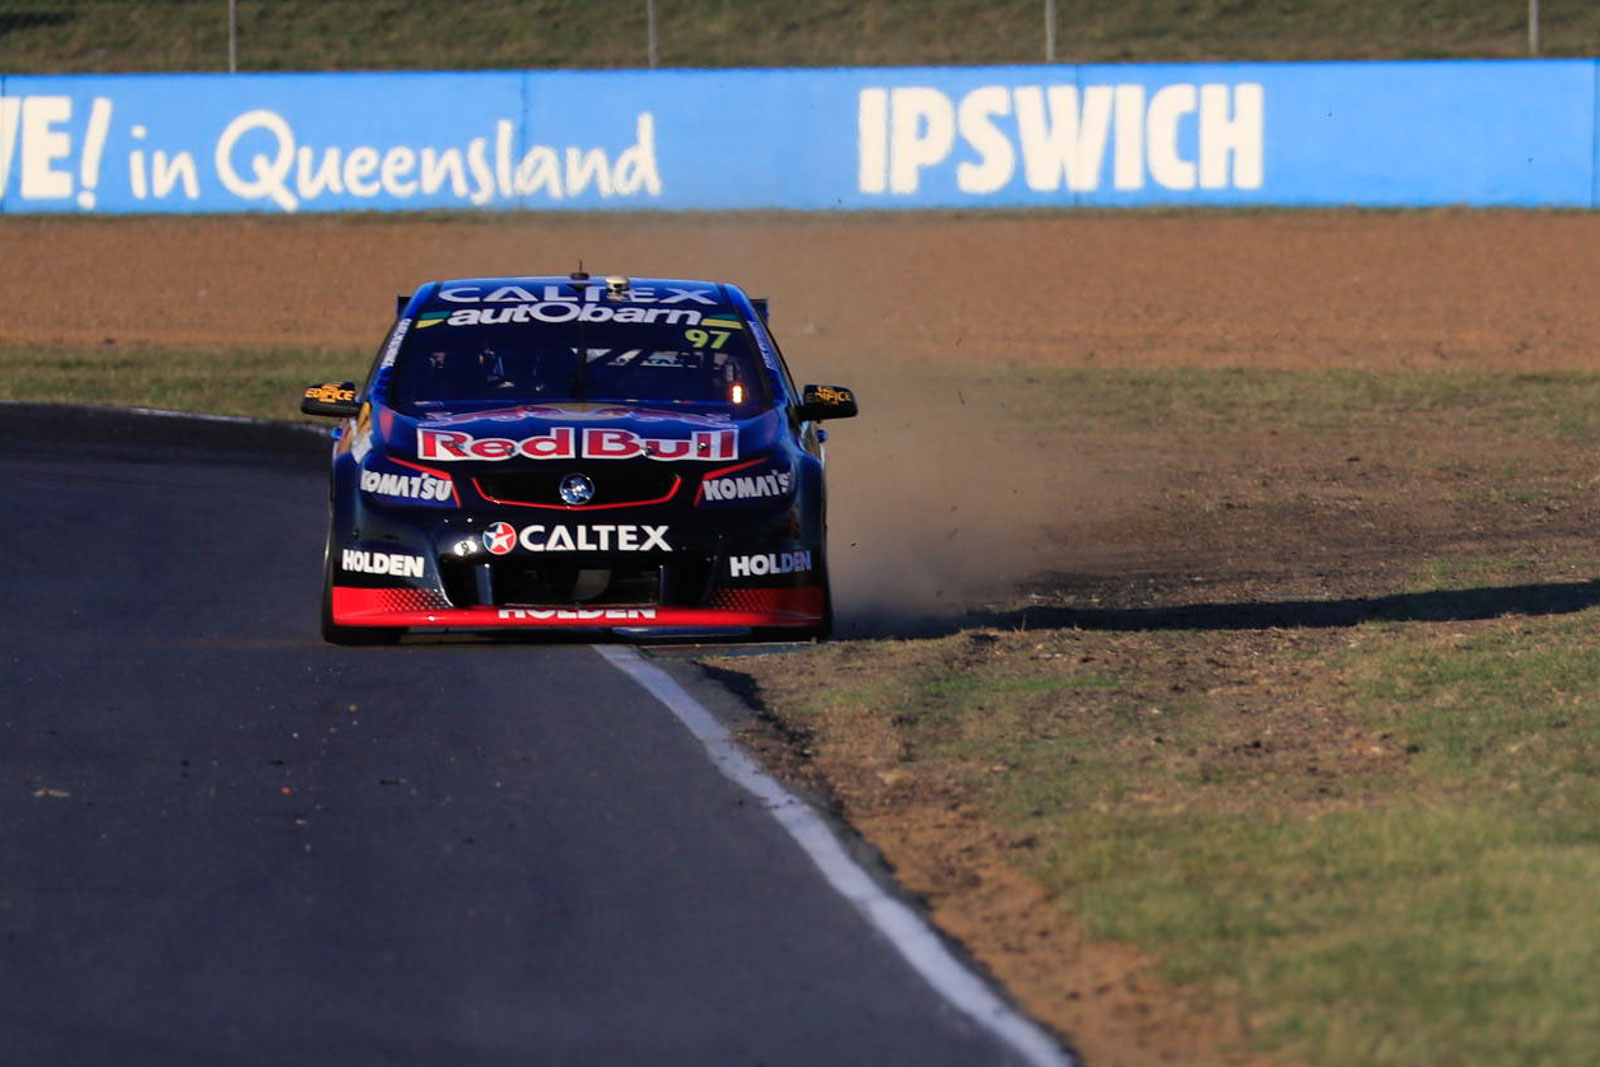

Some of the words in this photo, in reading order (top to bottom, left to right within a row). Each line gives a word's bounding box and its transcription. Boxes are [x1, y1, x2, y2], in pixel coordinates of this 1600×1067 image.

[858, 83, 1263, 193] IPSWICH
[130, 125, 199, 199] in
[215, 110, 662, 212] Queensland
[437, 285, 718, 304] CALTEX
[684, 328, 731, 350] 97
[417, 427, 575, 460] Red
[581, 428, 739, 461] Bull
[519, 524, 673, 553] CALTEX
[341, 549, 424, 578] HOLDEN
[729, 550, 812, 578] HOLDEN
